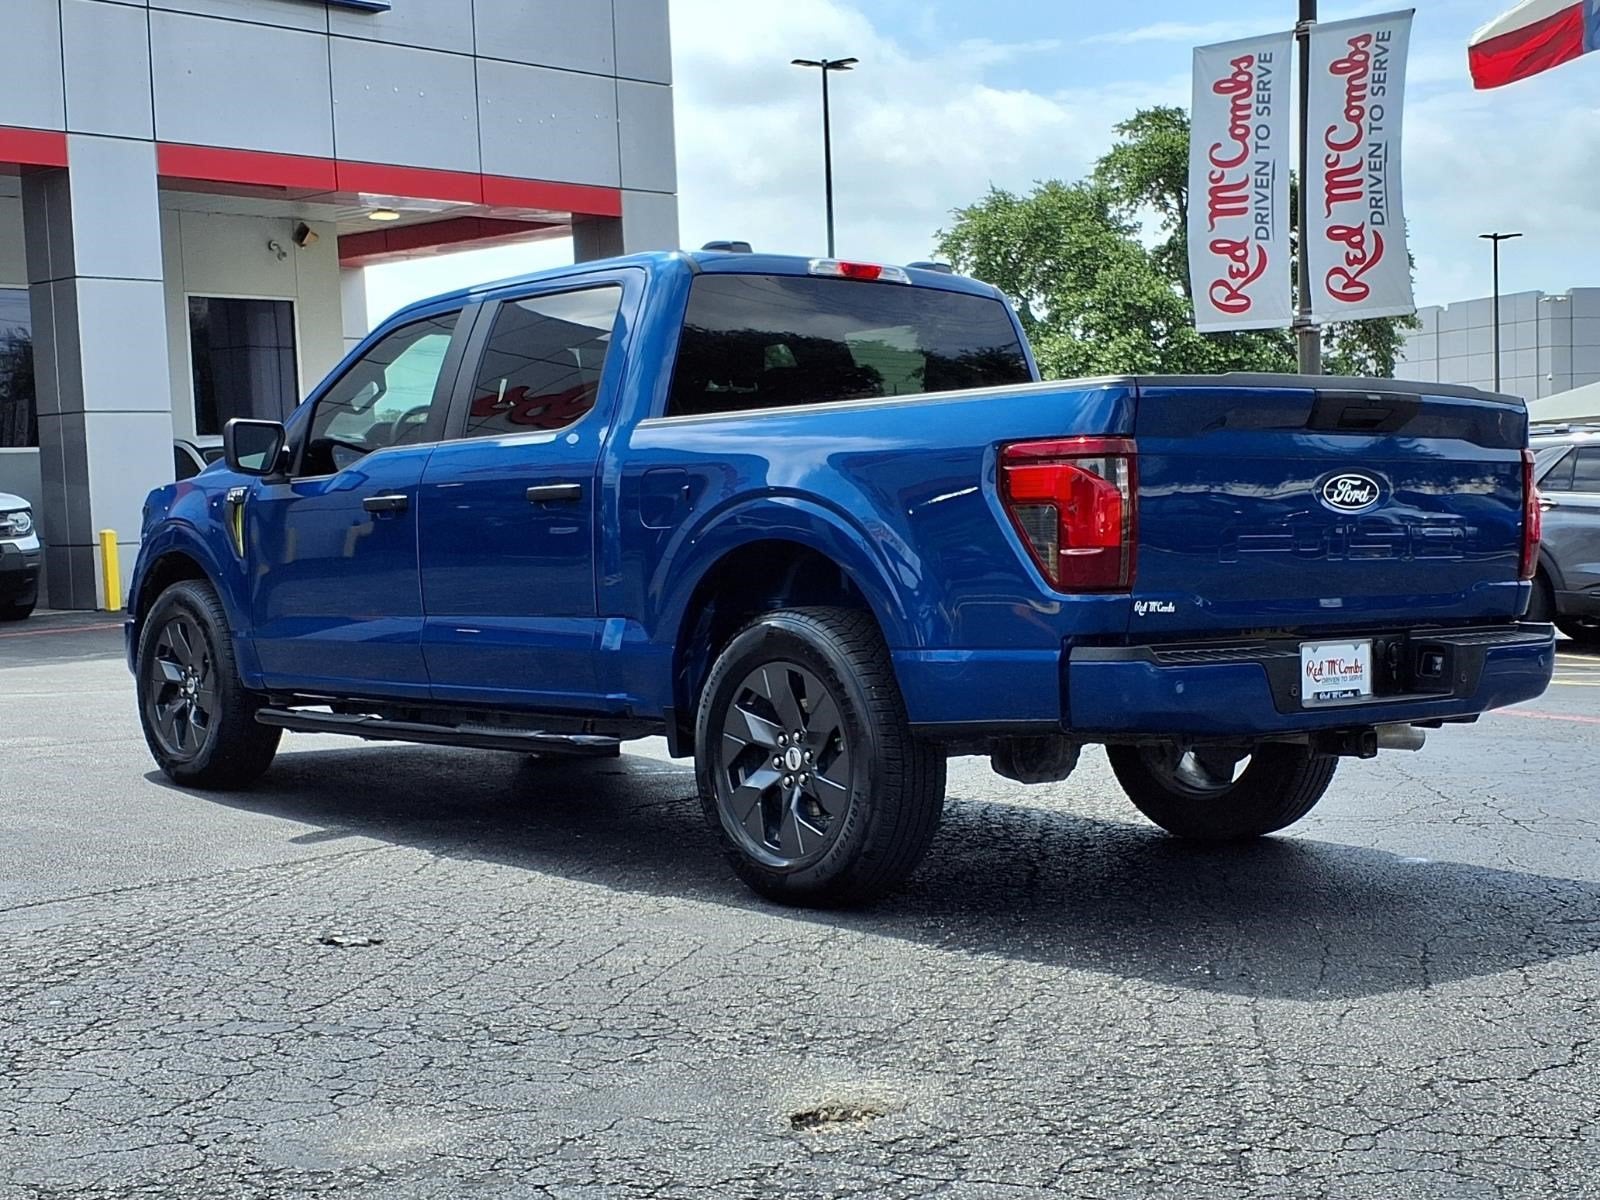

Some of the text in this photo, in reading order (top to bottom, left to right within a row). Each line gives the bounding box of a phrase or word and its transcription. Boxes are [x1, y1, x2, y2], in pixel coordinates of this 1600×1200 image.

[1208, 54, 1267, 314] Red McCombs
[1254, 52, 1273, 241] DRIVEN TO SERVE
[1324, 33, 1384, 302] Red McCombs
[1369, 30, 1391, 226] DRIVEN TO SERVE
[1332, 478, 1370, 503] Ford
[1134, 600, 1148, 616] Red
[1306, 658, 1363, 682] Red McCombs
